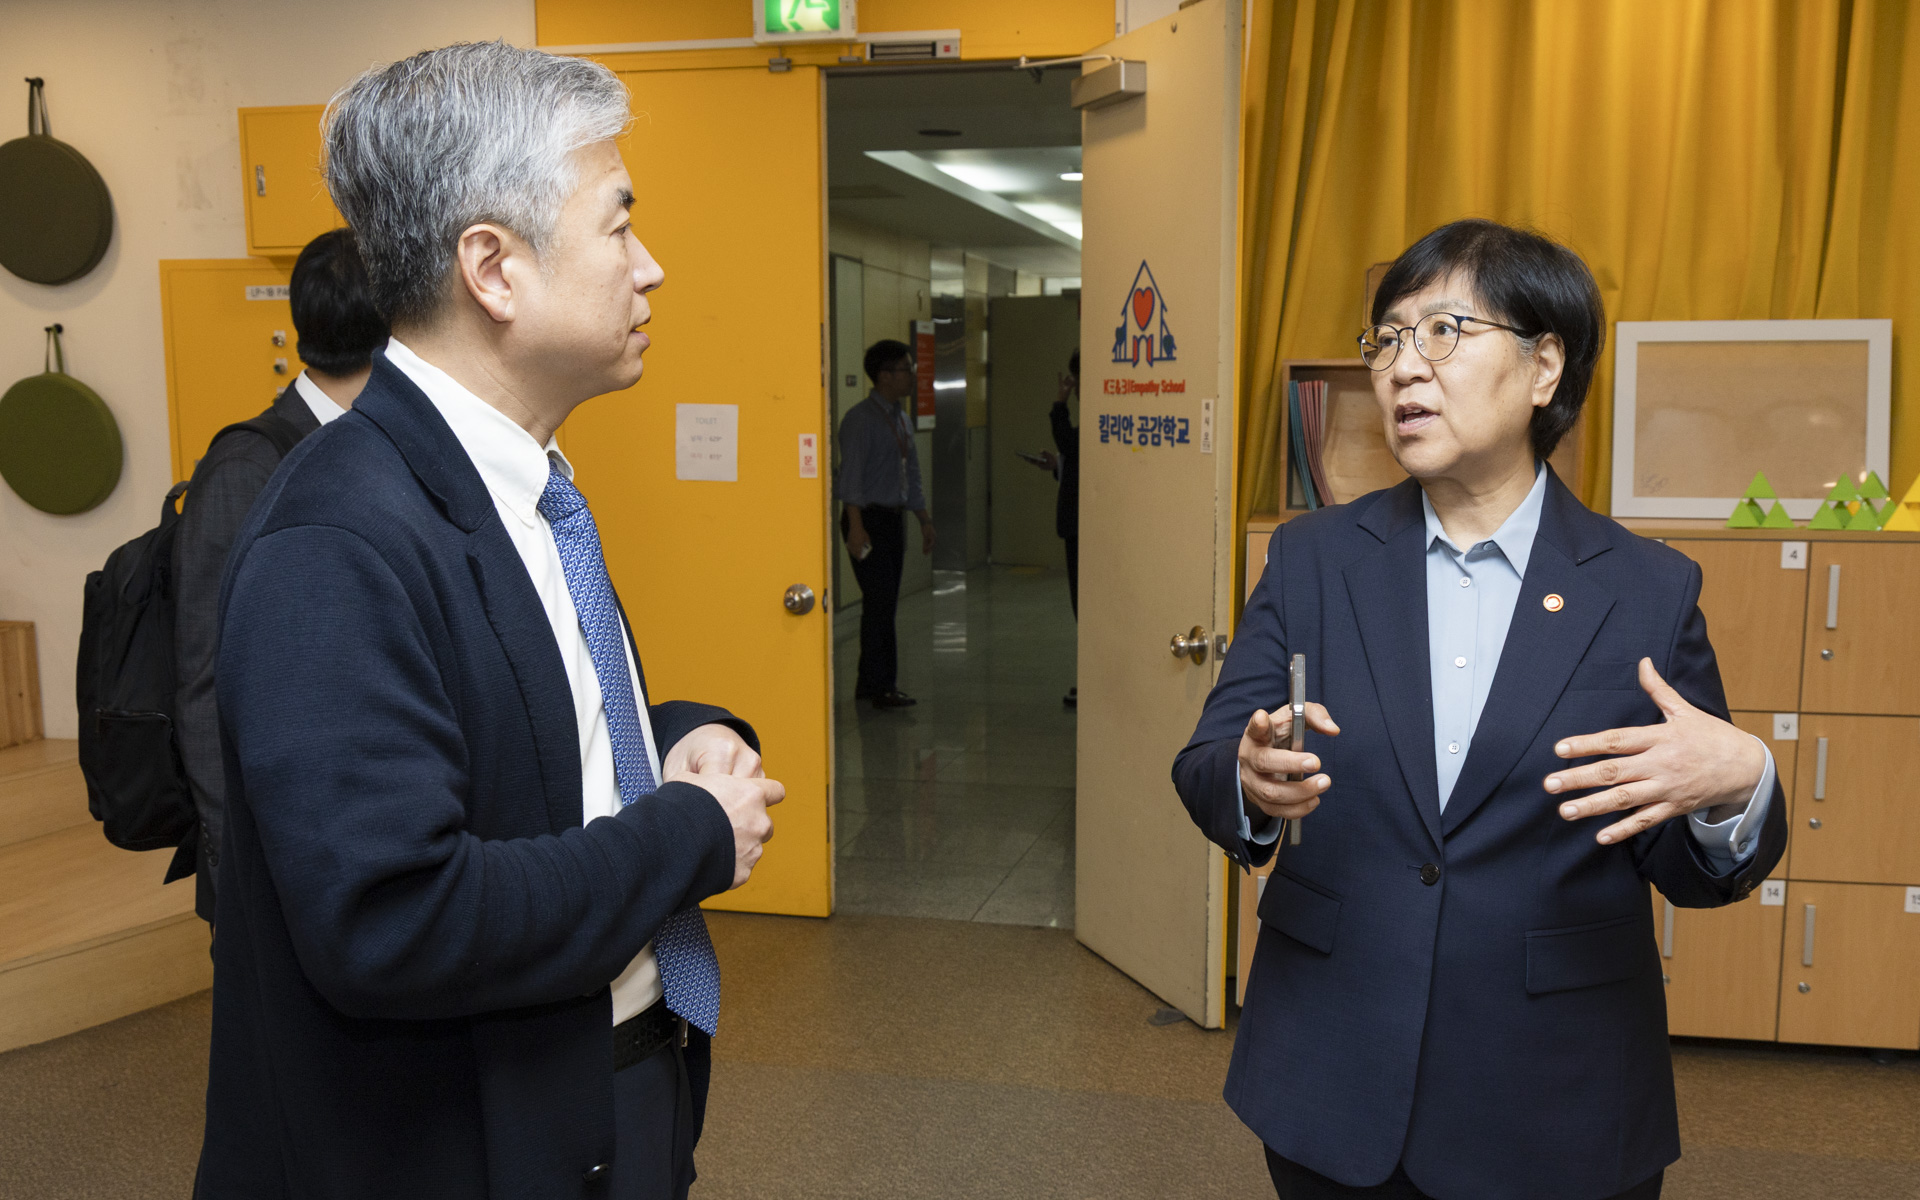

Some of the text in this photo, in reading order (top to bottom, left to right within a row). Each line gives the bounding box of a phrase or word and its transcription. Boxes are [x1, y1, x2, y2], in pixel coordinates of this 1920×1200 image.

[1131, 379, 1160, 397] Empathy
[1161, 379, 1186, 392] School
[1099, 414, 1190, 447] 킬리안 공감학교
[1790, 550, 1798, 560] 4
[1781, 722, 1790, 733] 9
[1767, 888, 1779, 898] 14
